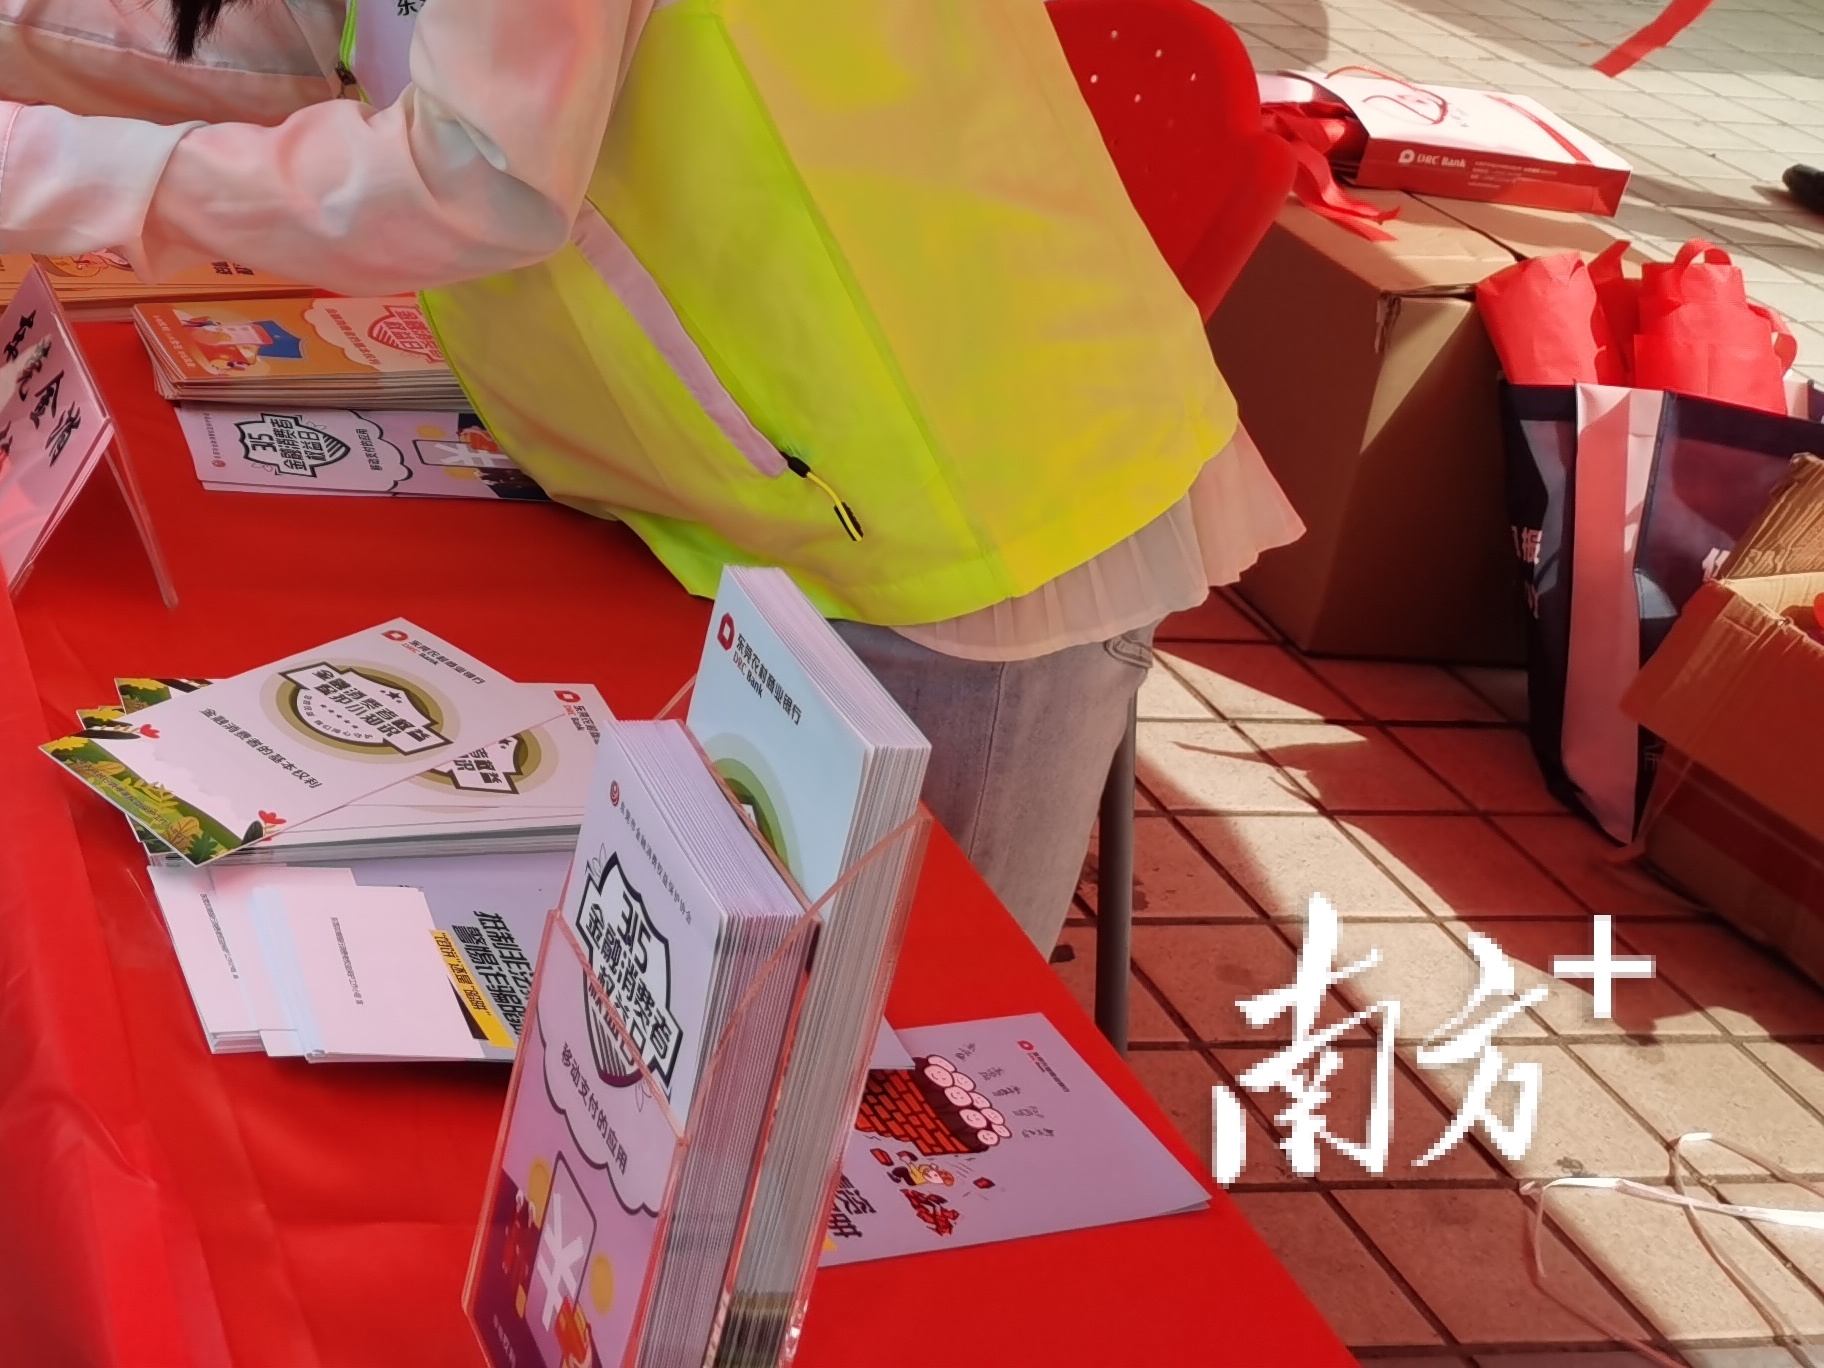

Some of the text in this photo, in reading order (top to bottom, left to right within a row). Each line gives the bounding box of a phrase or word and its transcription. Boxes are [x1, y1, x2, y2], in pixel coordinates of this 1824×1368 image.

[270, 418, 307, 472] 金融消费者
[297, 429, 327, 462] 权益日
[407, 639, 486, 685] 东莞农村商业银行
[735, 632, 803, 726] 东莞农村商业银行
[746, 669, 764, 699] Bank
[312, 668, 432, 743] 金融消费者权益
[313, 682, 402, 738] 保护小知识
[198, 706, 324, 790] 金融消费者的基本权利
[585, 902, 673, 1060] 金融消费者
[559, 1042, 629, 1176] 移动支付的应用
